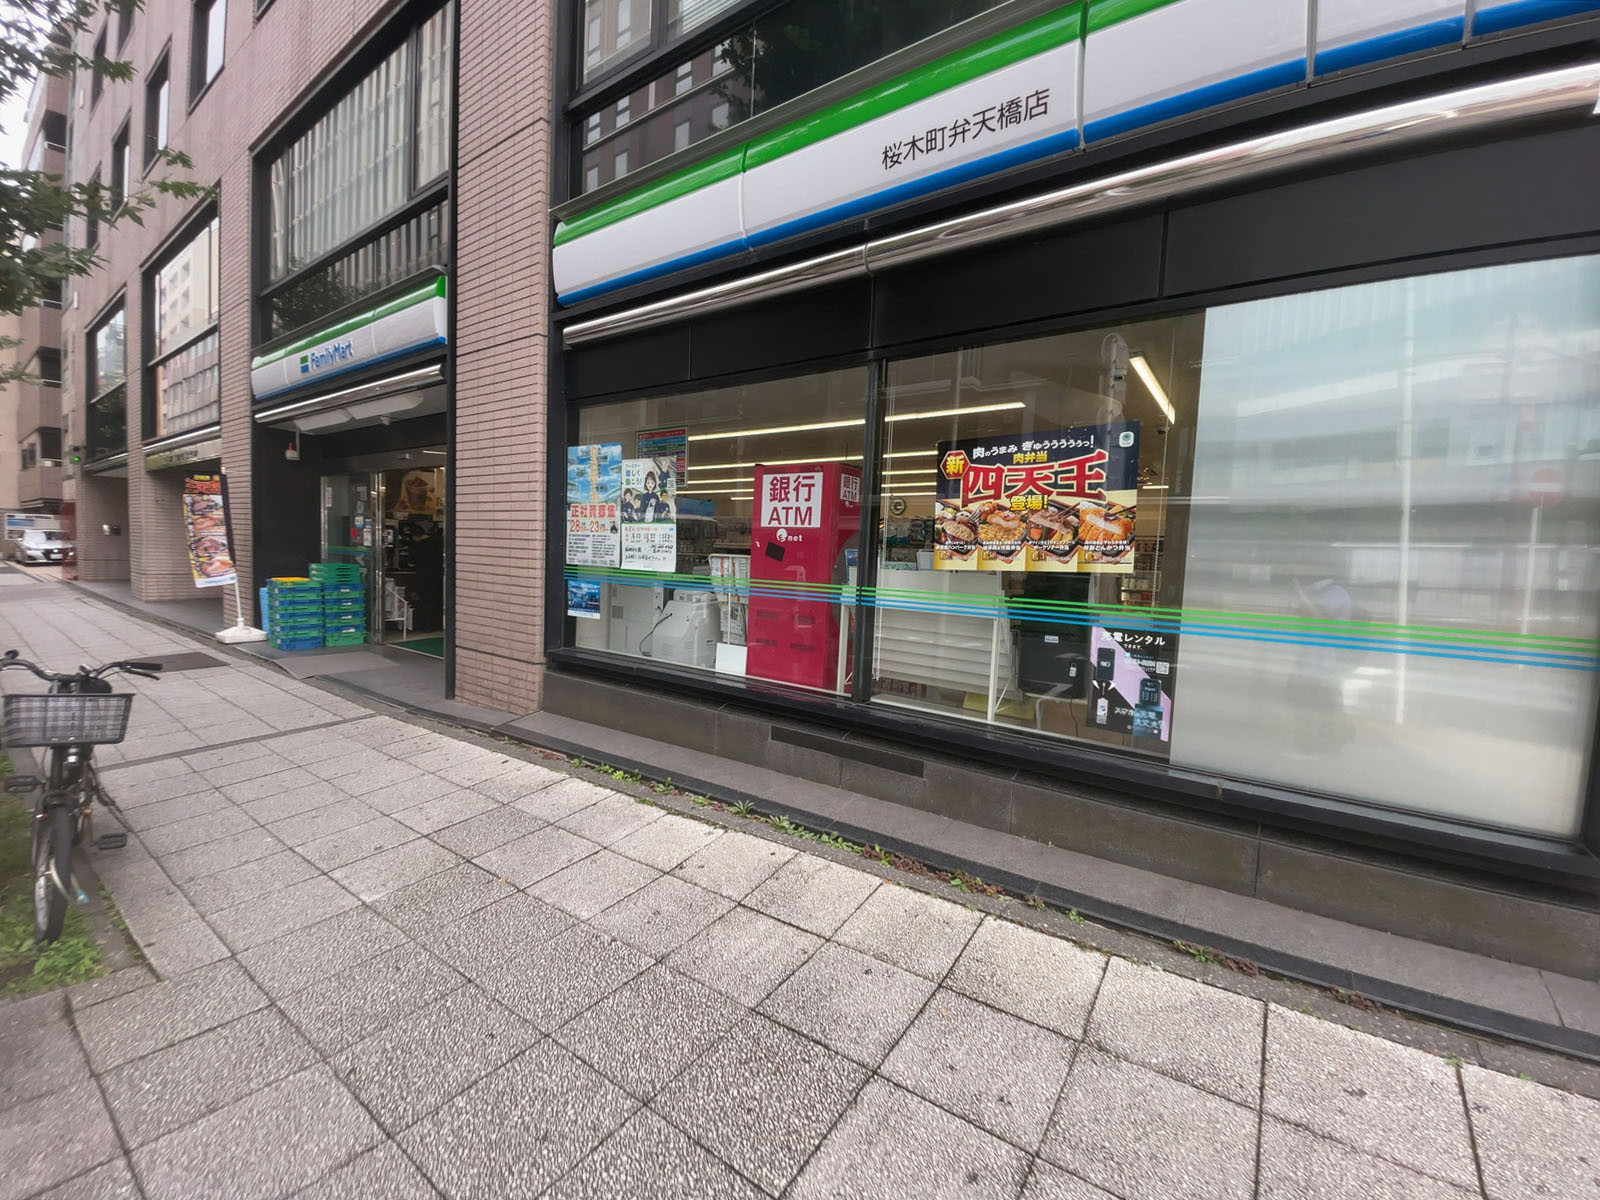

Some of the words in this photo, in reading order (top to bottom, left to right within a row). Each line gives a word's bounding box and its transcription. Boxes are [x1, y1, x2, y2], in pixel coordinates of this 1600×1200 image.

[881, 88, 1050, 170] 桜木町弁天橋店
[310, 341, 353, 371] FamilyMart
[972, 445, 1018, 460] 肉のうまみ
[1013, 450, 1048, 464] 肉弁当
[946, 454, 965, 475] 新
[769, 475, 816, 503] 銀行
[960, 450, 1108, 509] 四天王
[1009, 495, 1049, 511] 登場!
[768, 506, 813, 526] ATM
[1101, 631, 1166, 646] 充電レンタル
